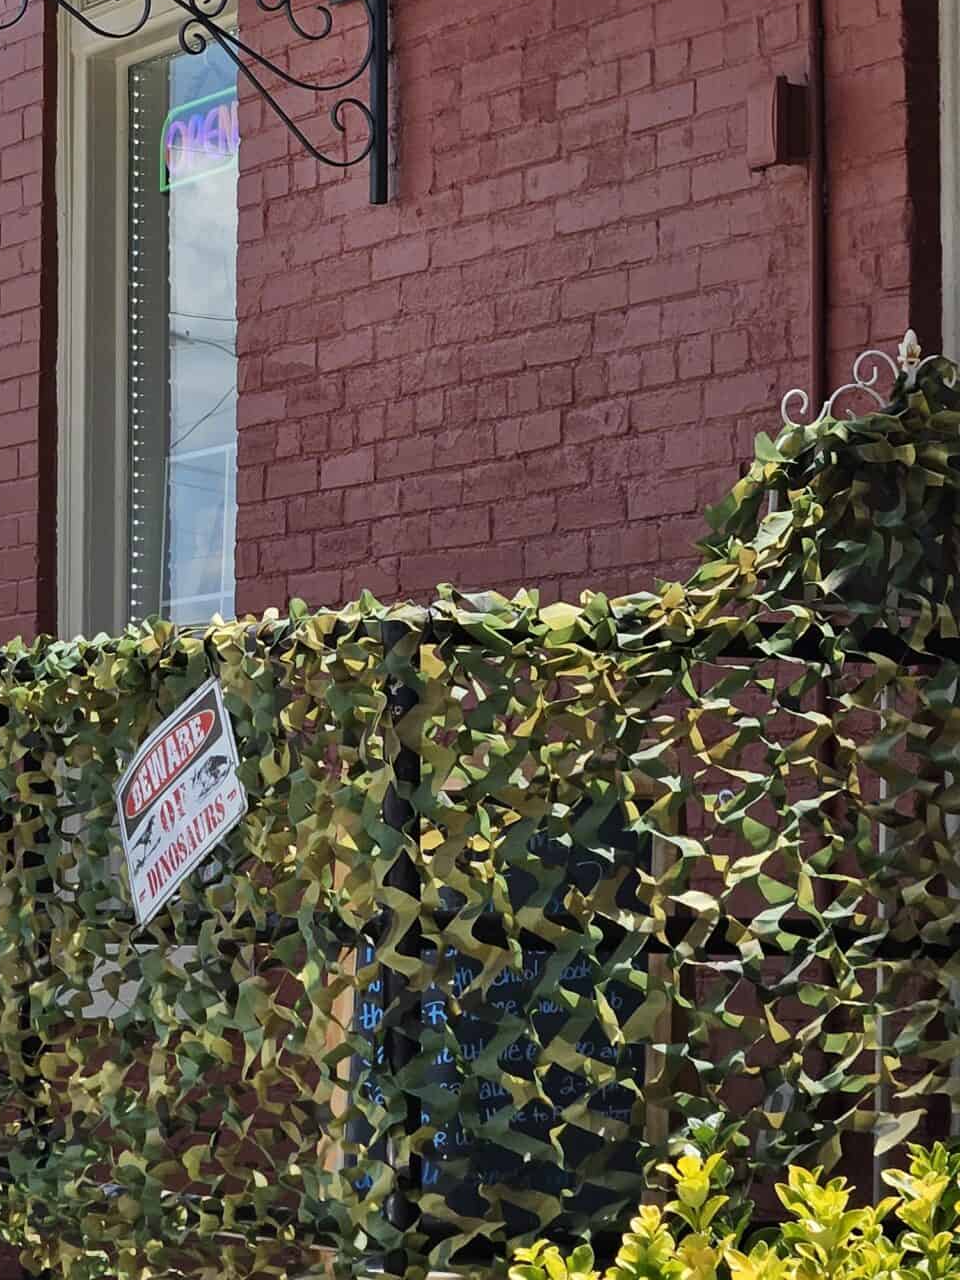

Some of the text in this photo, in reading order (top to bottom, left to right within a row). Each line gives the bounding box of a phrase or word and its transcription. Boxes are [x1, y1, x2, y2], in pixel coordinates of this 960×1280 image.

[166, 100, 239, 173] OPEN
[129, 713, 206, 813] BEWARE
[146, 793, 227, 898] DINOSAURS
[159, 782, 188, 833] OF
